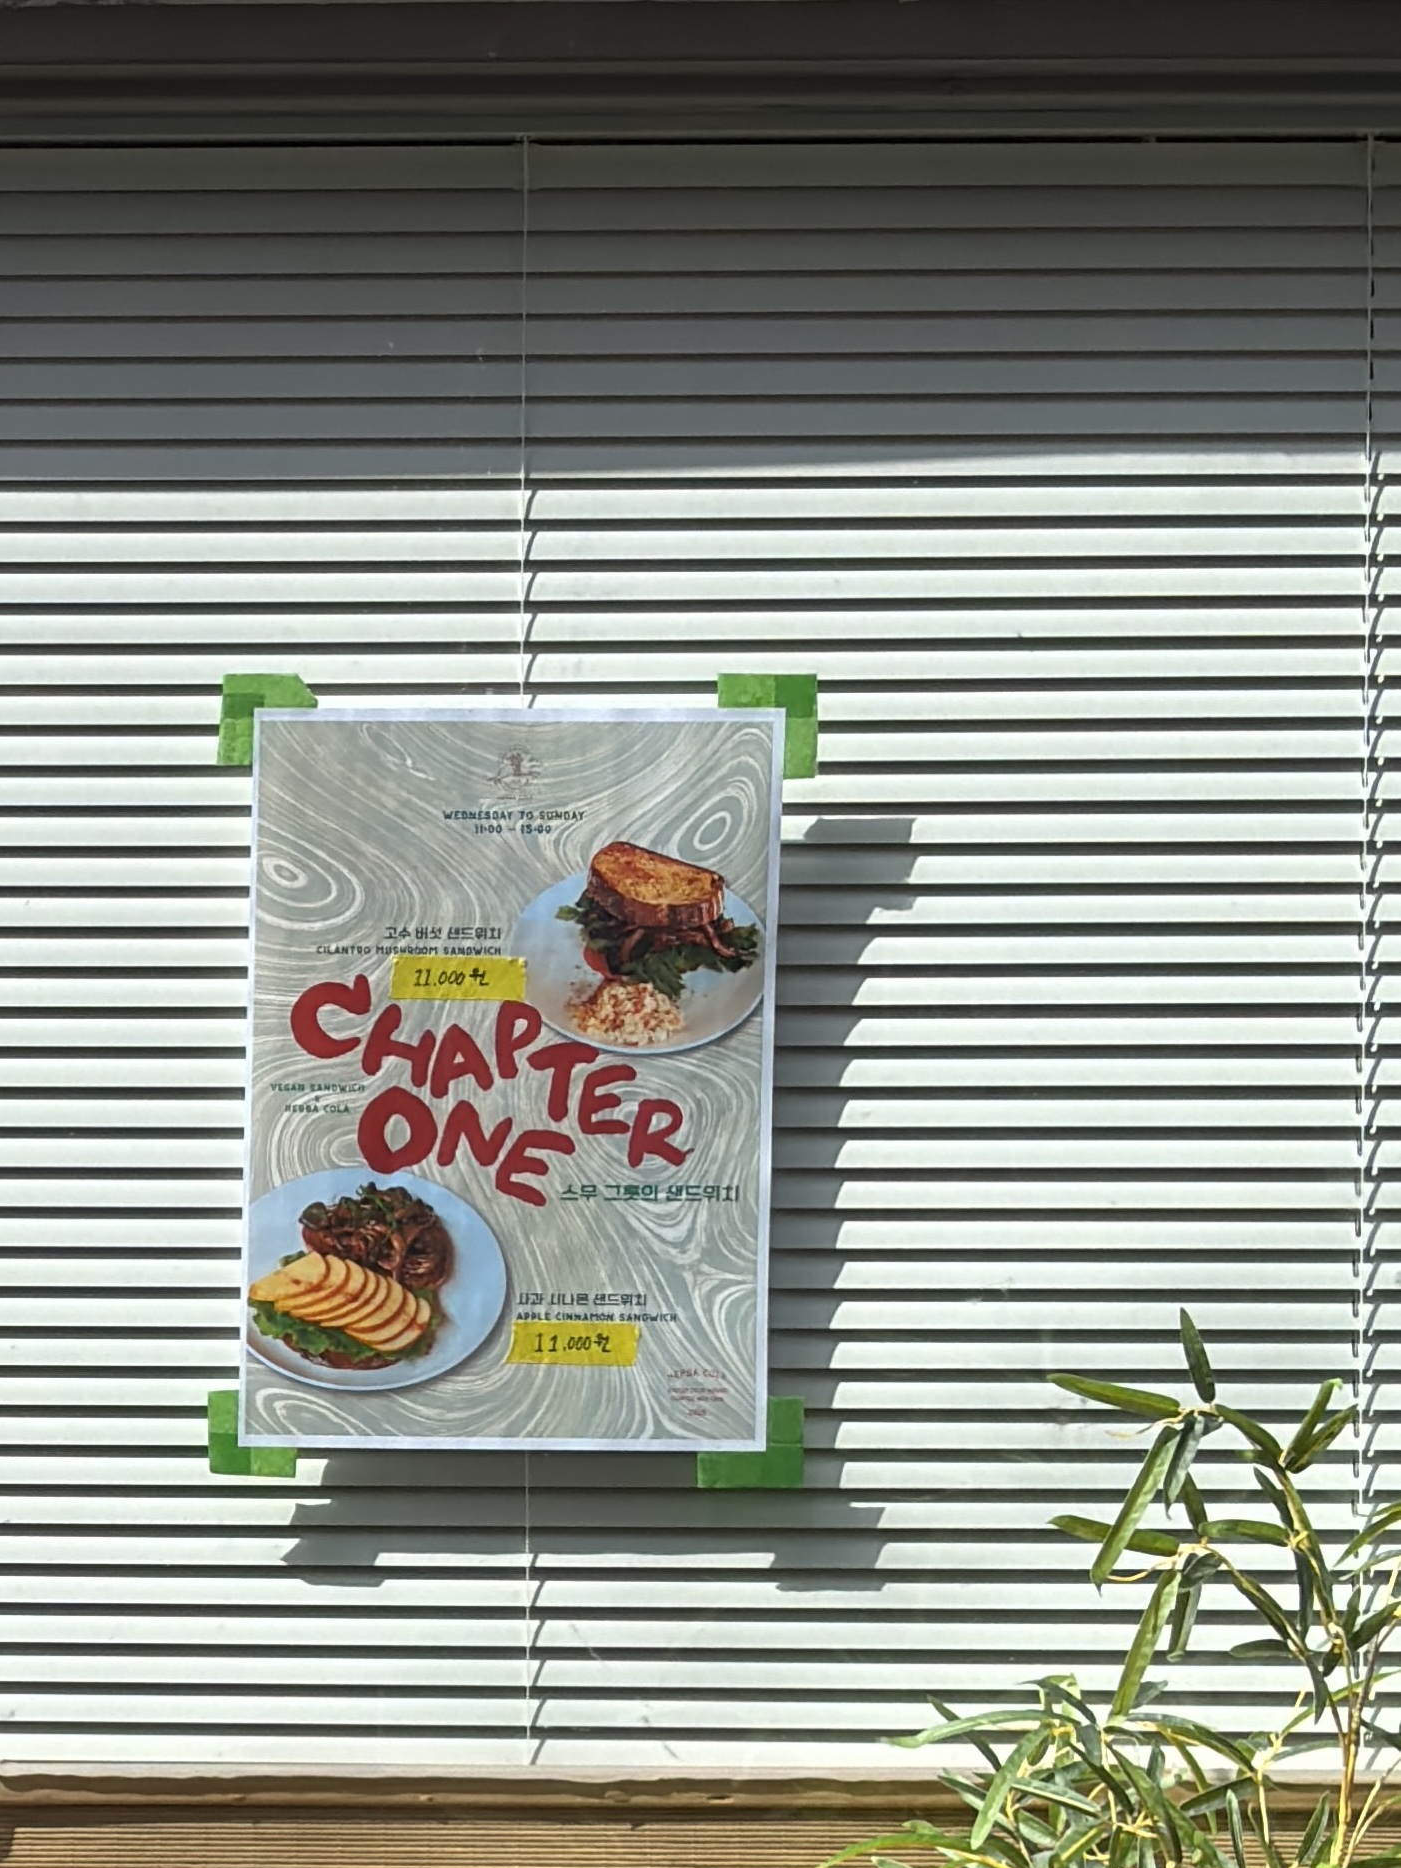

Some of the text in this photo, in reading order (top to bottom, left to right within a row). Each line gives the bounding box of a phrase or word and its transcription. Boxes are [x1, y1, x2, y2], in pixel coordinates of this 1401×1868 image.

[442, 810, 585, 821] WEDNESDAY TO SUNDAY
[384, 927, 502, 940] 고수 버섯 샌드위치
[316, 945, 502, 956] CILANTRO MUSHROOM SANDWICH
[290, 974, 695, 1168] CHAPTER
[270, 1083, 366, 1093] VEGAN SANDWICH
[323, 1104, 350, 1113] COLA
[358, 1086, 575, 1207] ONE
[560, 1184, 597, 1201] 스무
[666, 1184, 740, 1202] 샌드위치
[518, 1293, 647, 1307] 사과 시나몬 샌드위치
[516, 1312, 677, 1322] APPLE CINNAMON SANDWICH
